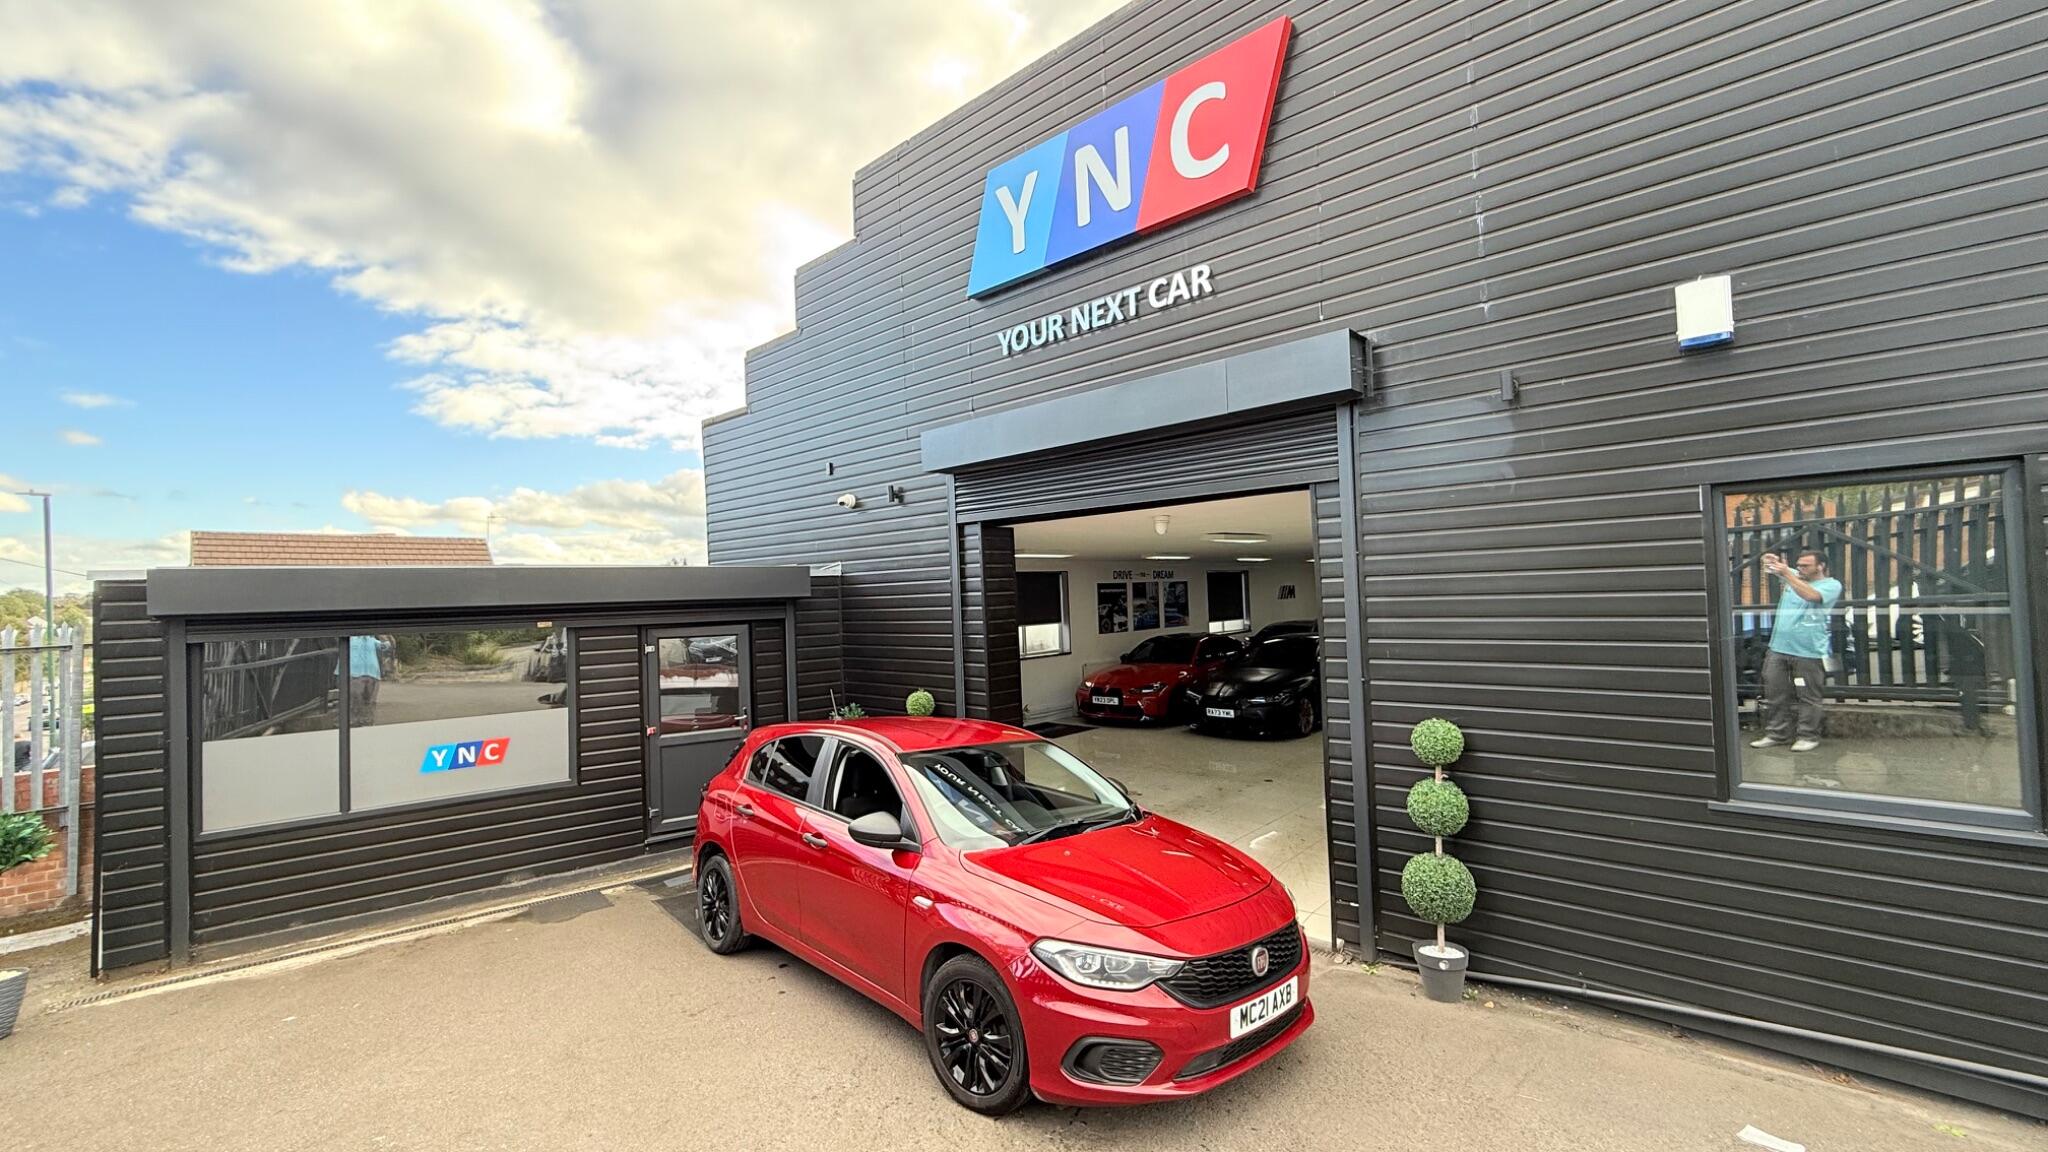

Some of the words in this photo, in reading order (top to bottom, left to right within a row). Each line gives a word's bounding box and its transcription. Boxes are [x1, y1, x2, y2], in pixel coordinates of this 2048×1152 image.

[995, 81, 1230, 254] YNC
[997, 313, 1064, 356] YOUR
[1071, 286, 1141, 334] NEXT
[1149, 264, 1213, 309] CAR
[1112, 570, 1133, 580] DRIVE
[1152, 570, 1175, 580] DREAM
[431, 743, 500, 768] YNC
[1240, 996, 1269, 1030] MC21
[1272, 983, 1292, 1014] AXB
